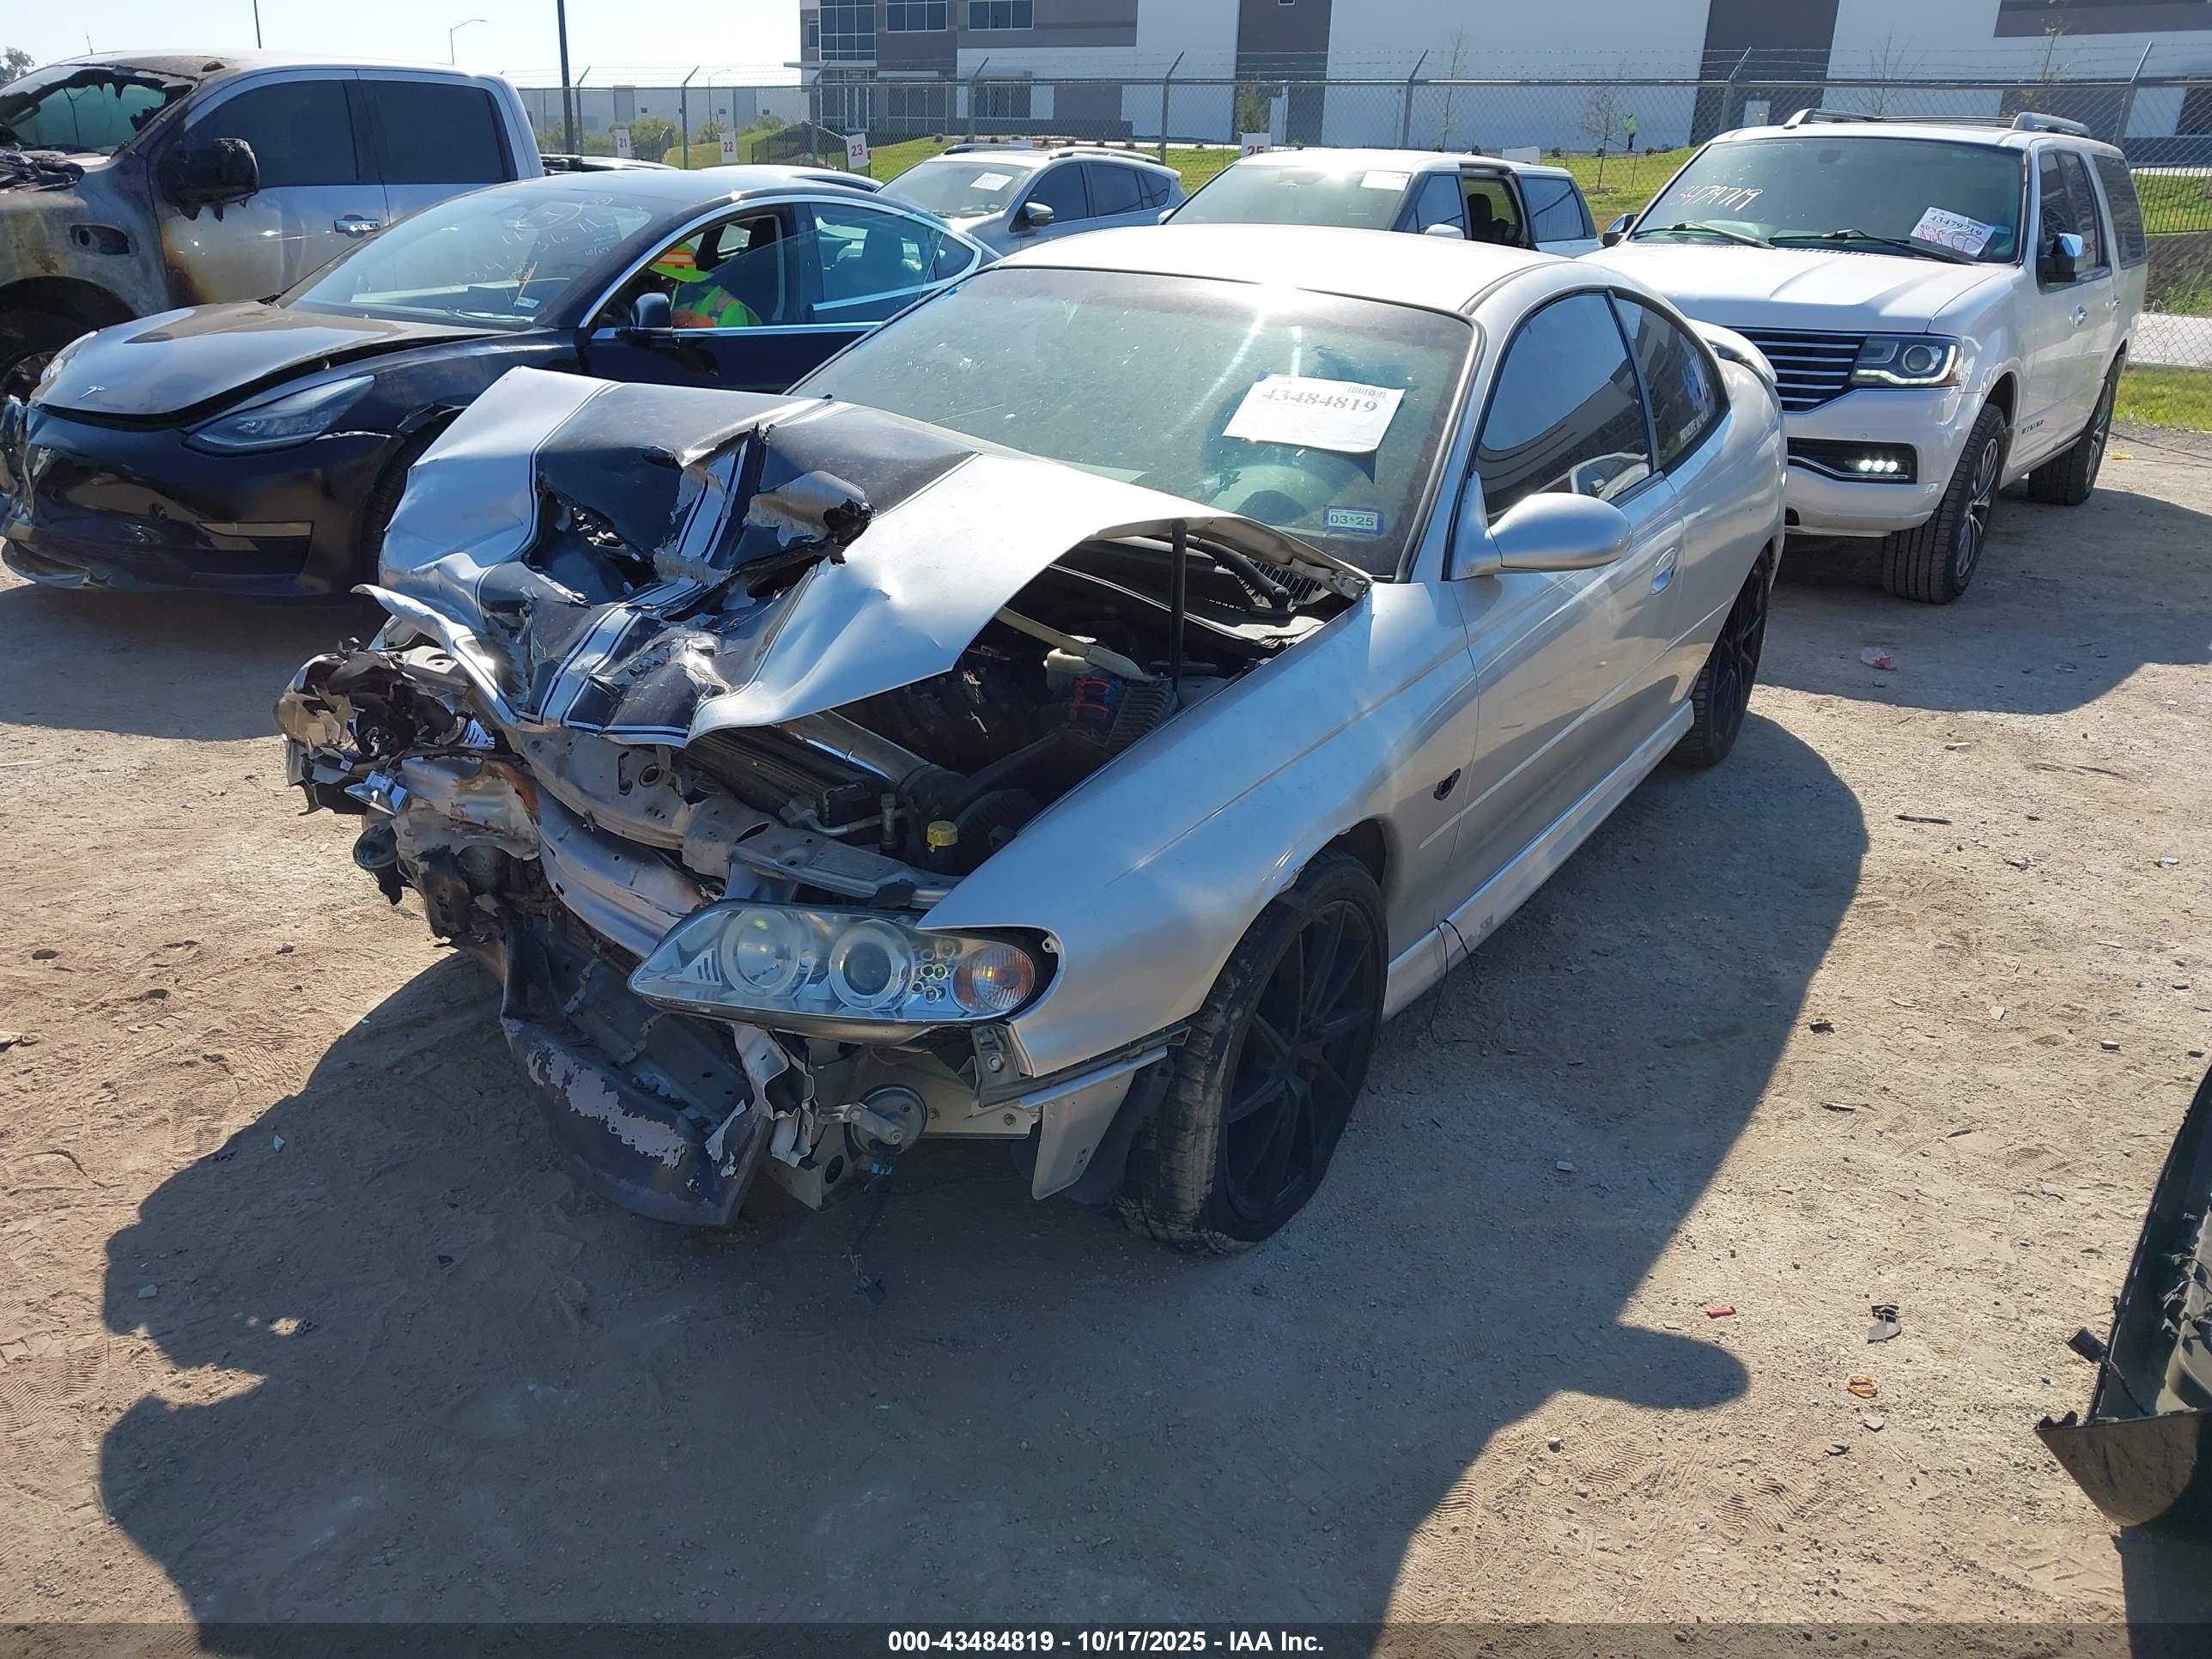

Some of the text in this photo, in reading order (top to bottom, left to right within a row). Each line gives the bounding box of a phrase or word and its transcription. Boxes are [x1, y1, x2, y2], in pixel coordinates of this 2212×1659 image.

[618, 137, 628, 149] 21
[723, 141, 734, 152] 22
[850, 143, 864, 157] 23
[1247, 144, 1265, 155] 25
[1261, 388, 1379, 413] 43484819
[1331, 514, 1375, 526] 03 25
